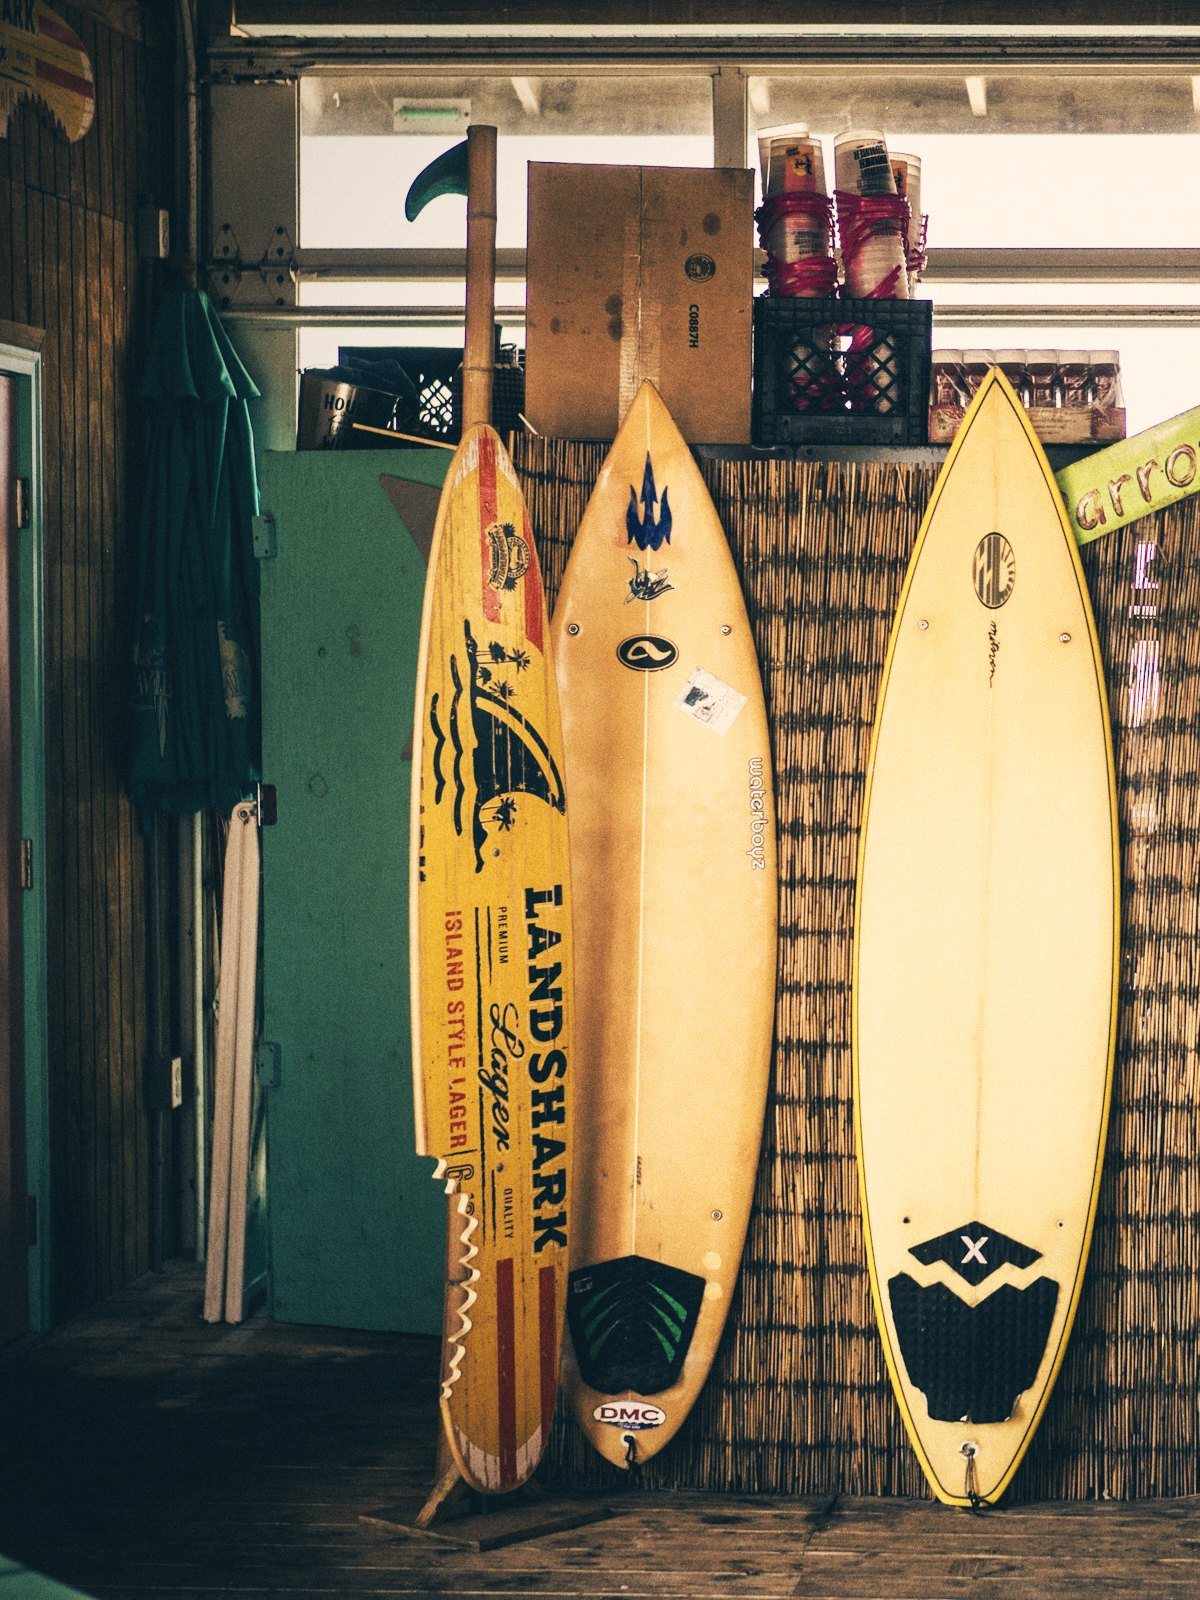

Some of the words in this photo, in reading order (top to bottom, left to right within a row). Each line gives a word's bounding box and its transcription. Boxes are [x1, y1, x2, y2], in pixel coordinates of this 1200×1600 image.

[688, 304, 699, 348] C0887H
[746, 757, 769, 870] waterboyz
[445, 910, 464, 991] ISLAND
[498, 906, 508, 964] PREMIUM
[447, 1001, 466, 1068] STYLE
[525, 884, 568, 1253] LANDSHARK
[478, 1003, 525, 1152] Lager
[448, 1078, 467, 1149] LAGER
[504, 1188, 514, 1238] QUALITY
[600, 1407, 660, 1421] DMC
